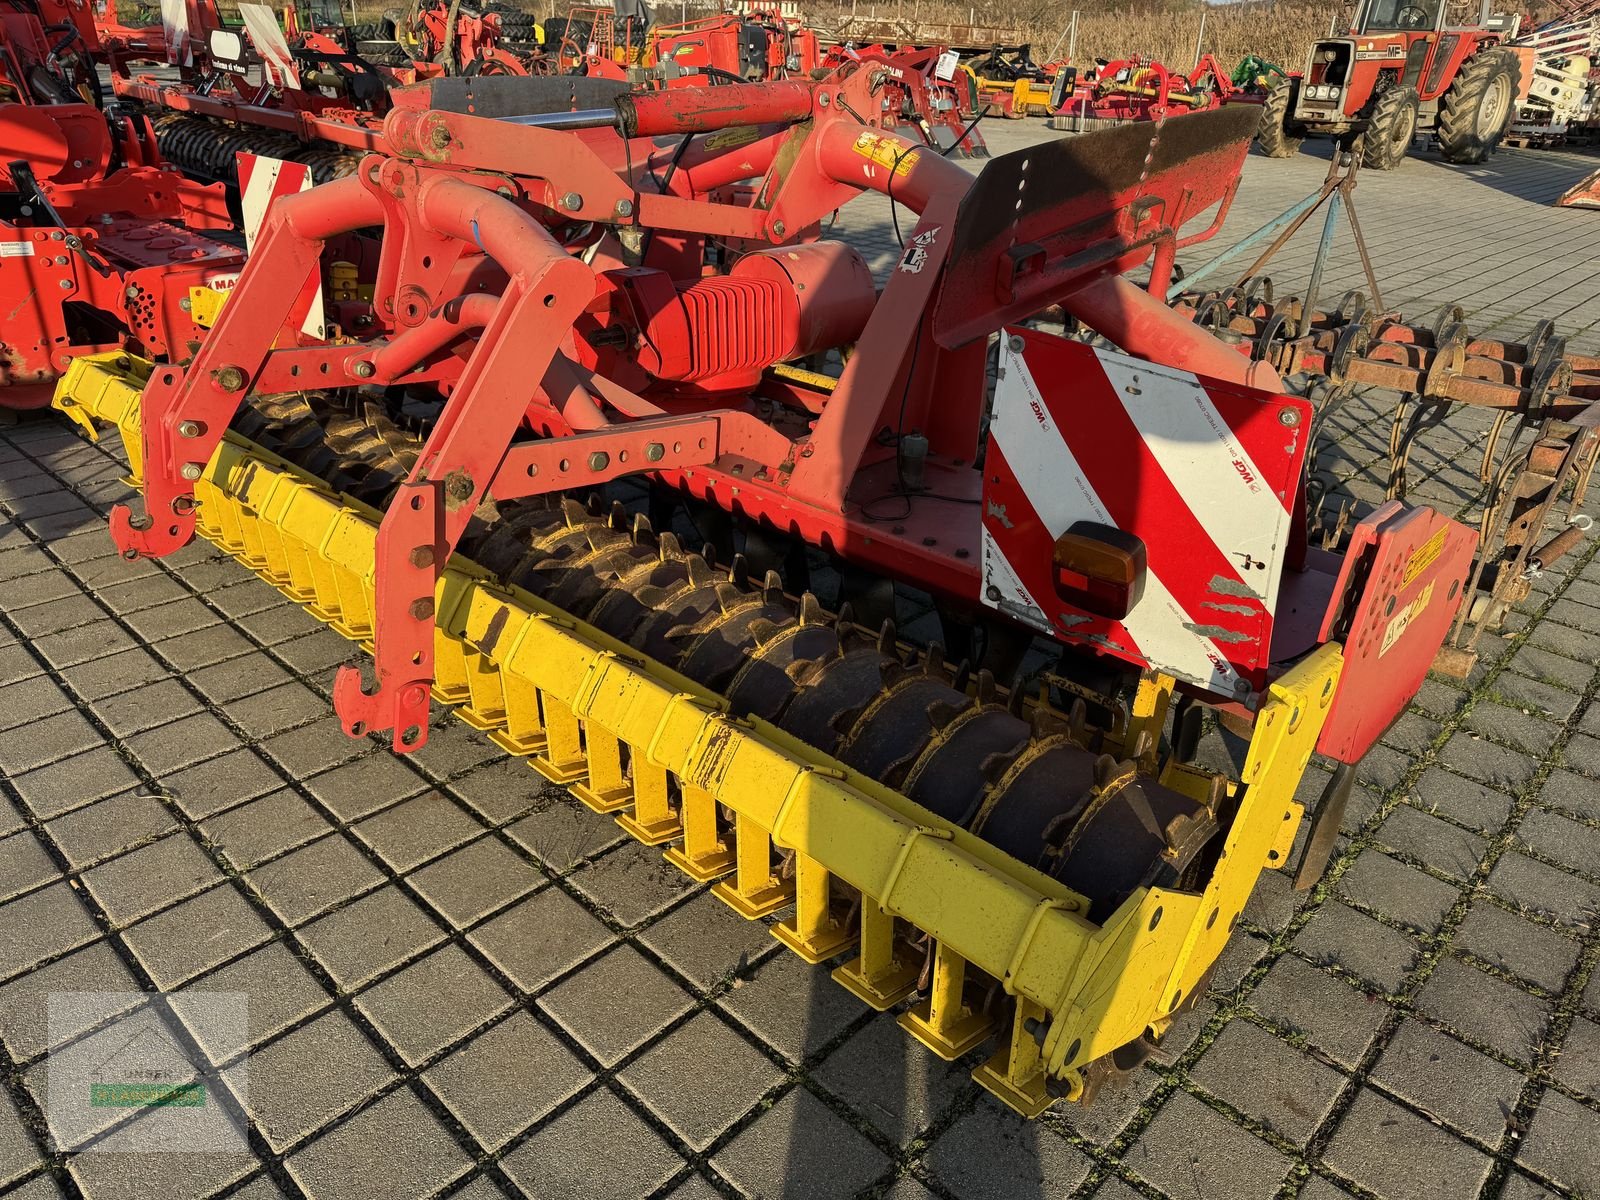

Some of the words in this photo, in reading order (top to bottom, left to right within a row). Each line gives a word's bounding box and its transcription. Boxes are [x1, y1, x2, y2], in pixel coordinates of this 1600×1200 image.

[1388, 46, 1400, 57] MF
[1029, 400, 1046, 423] WGF
[1218, 432, 1230, 447] 11030
[1228, 447, 1237, 457] DIN
[1232, 459, 1254, 484] WGF
[1206, 653, 1227, 675] WGF
